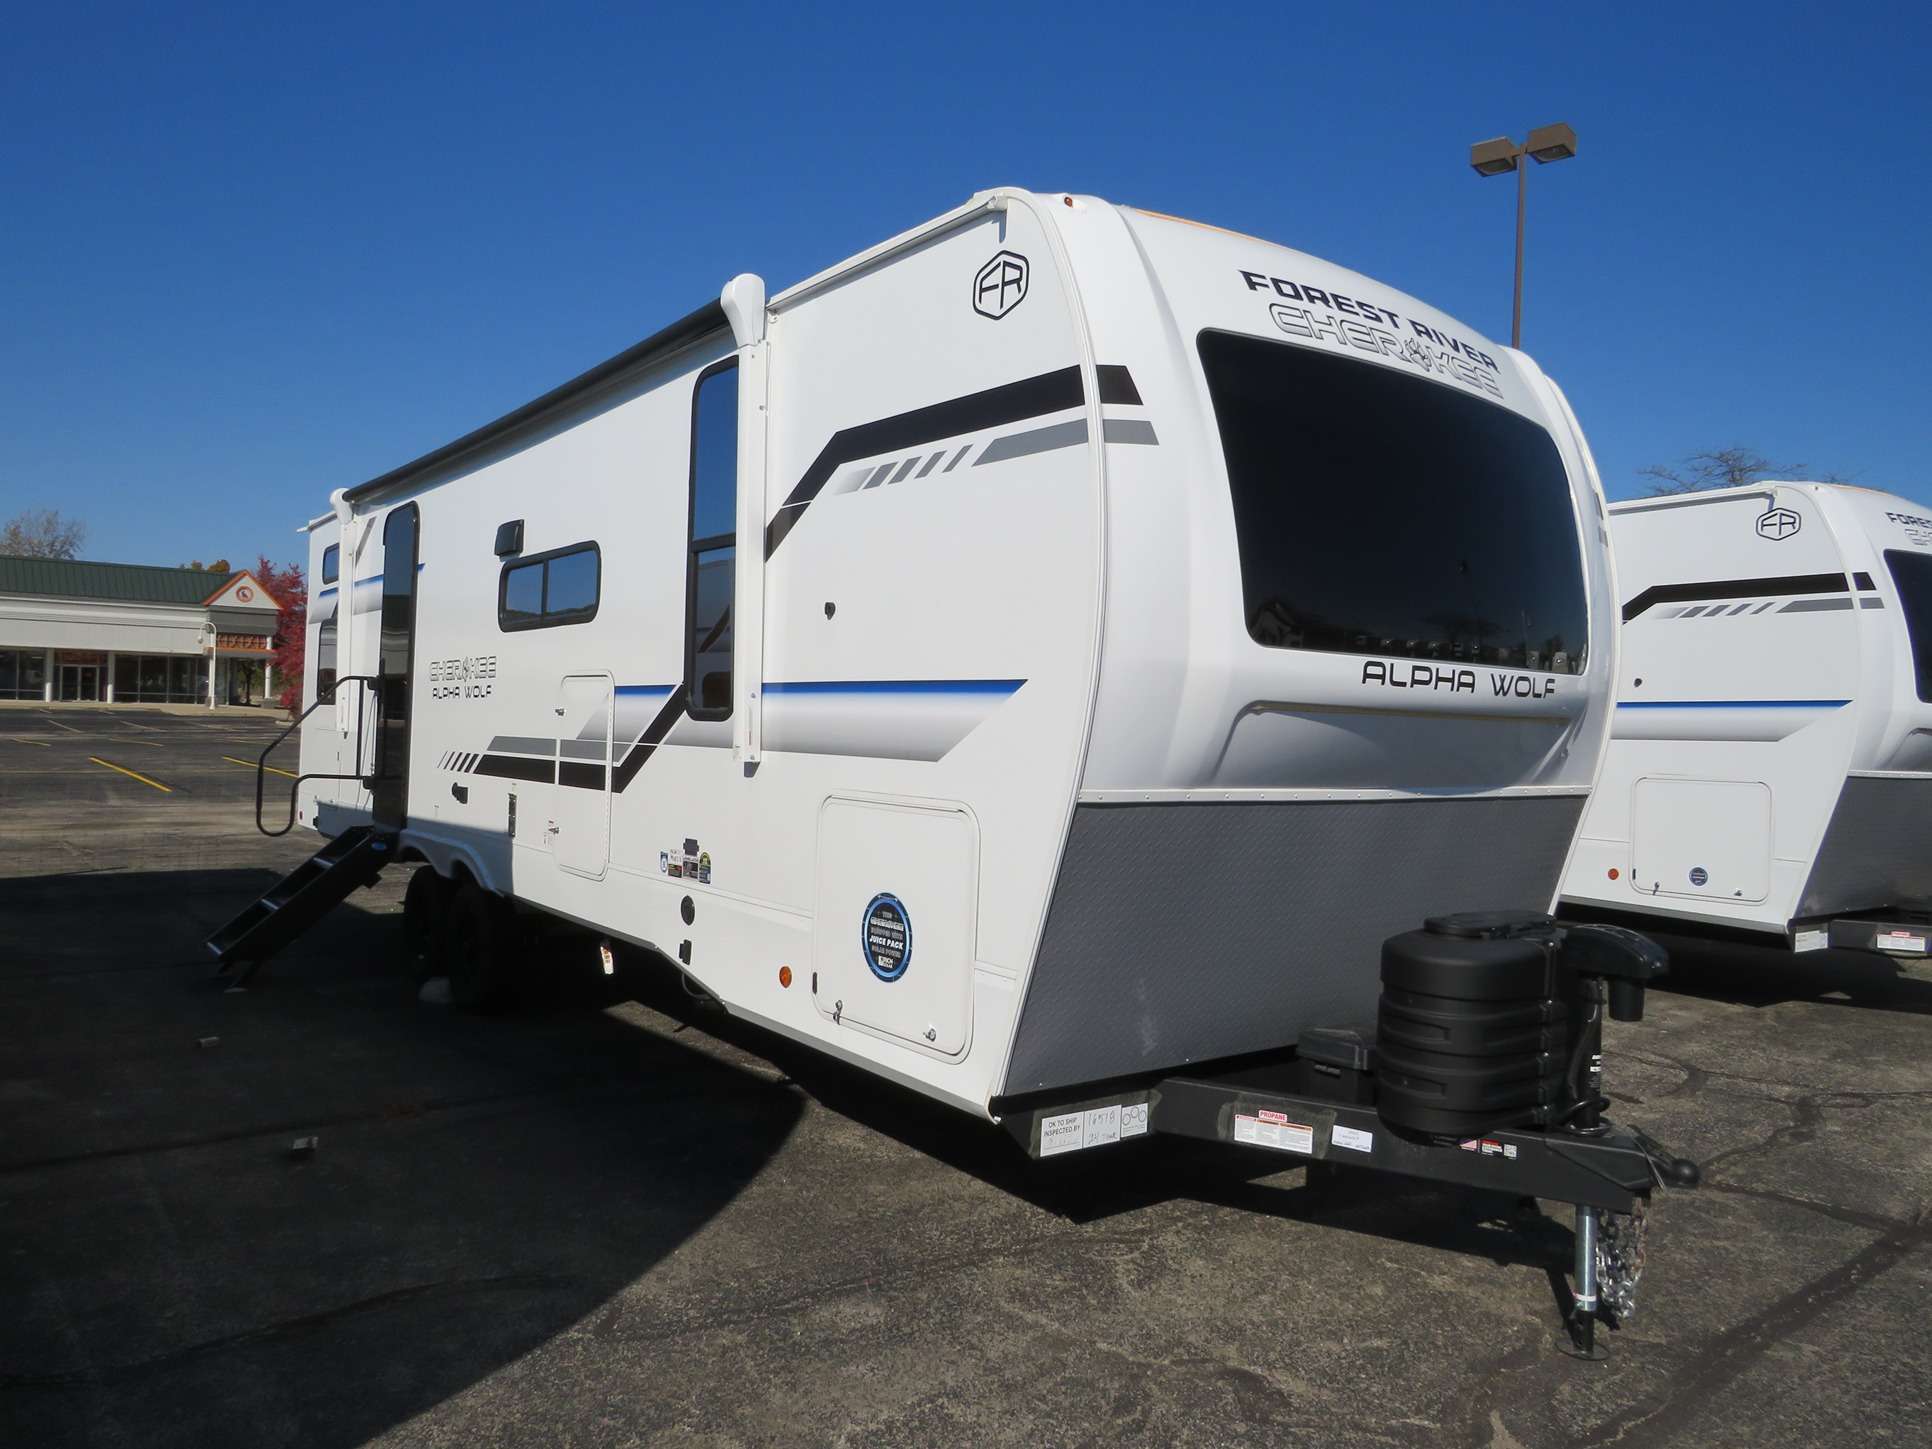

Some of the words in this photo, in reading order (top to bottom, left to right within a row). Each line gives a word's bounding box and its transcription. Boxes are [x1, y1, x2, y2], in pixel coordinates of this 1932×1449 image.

[1238, 269, 1399, 329] FOREST
[1407, 318, 1501, 374] RIVER
[1362, 660, 1476, 694] ALPHA
[1491, 673, 1556, 699] WOLF
[432, 686, 460, 699] ALPHA
[465, 684, 492, 698] WOLF
[886, 939, 903, 950] PACK
[1260, 1111, 1287, 1121] PROPANE
